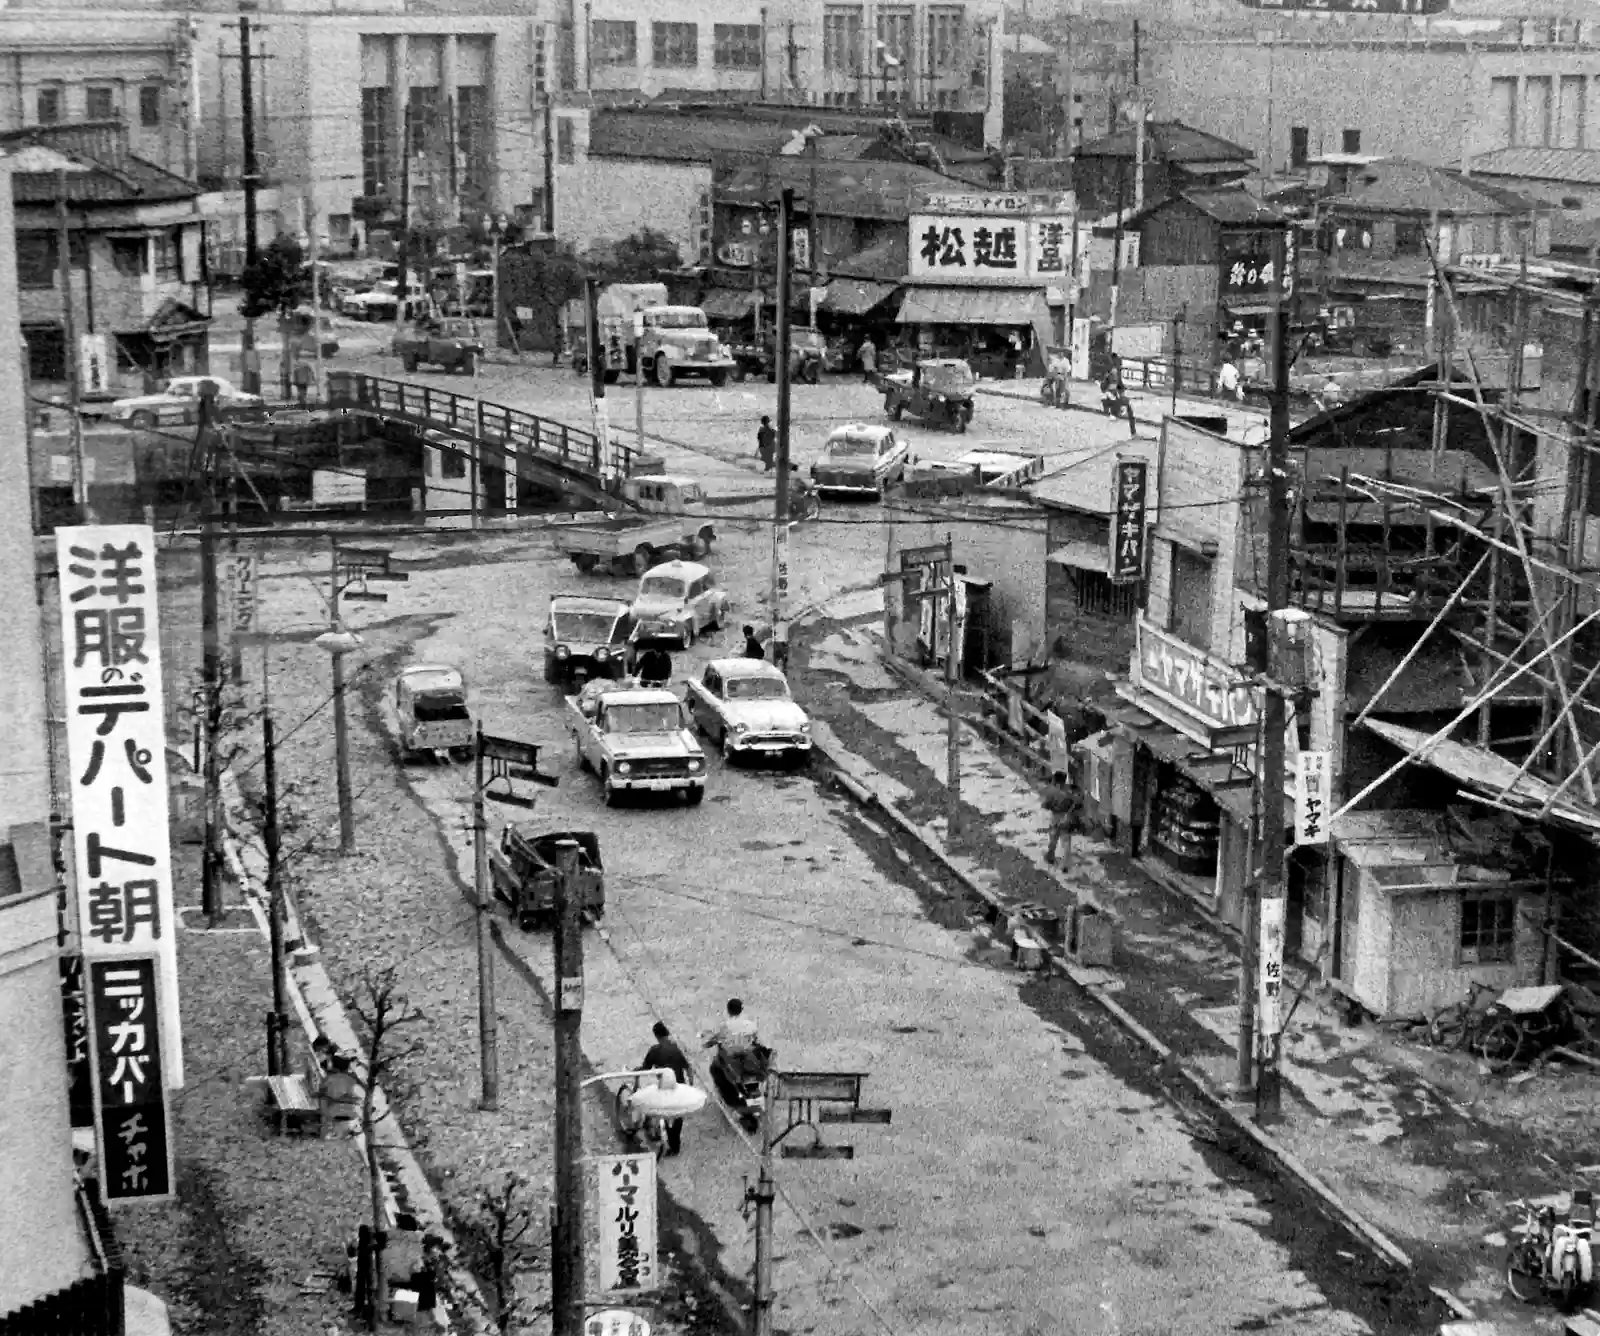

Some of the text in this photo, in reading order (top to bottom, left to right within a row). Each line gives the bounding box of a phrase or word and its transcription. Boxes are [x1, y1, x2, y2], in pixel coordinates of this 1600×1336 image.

[921, 225, 1017, 268] 松越
[1037, 223, 1064, 272] 洋品
[69, 542, 161, 943] 洋服のデパート朝
[104, 969, 149, 1104] ニッカバー
